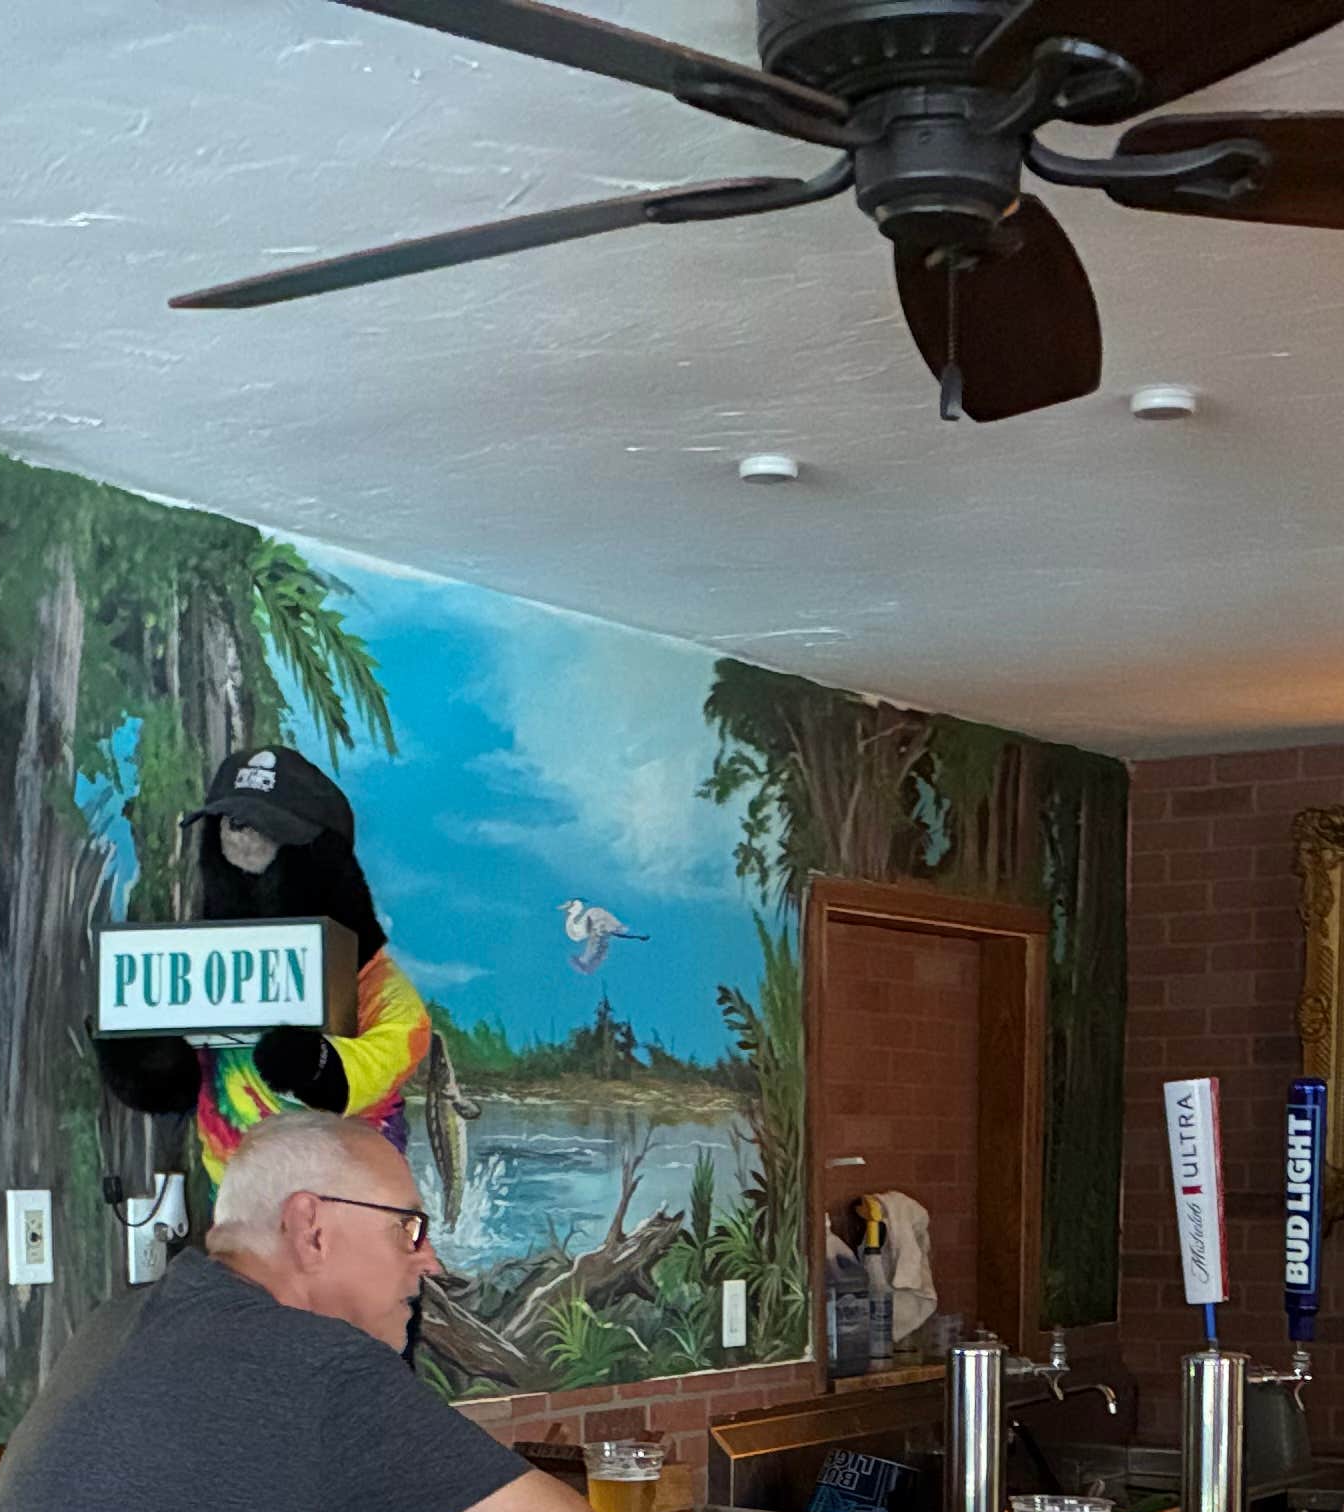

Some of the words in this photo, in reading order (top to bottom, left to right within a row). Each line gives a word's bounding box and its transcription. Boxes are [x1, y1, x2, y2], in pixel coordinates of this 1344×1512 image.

[113, 951, 193, 1008] PUB
[203, 946, 307, 1006] OPEN
[1176, 1093, 1199, 1179] ULTRA
[1286, 1113, 1313, 1212] LIGHT
[1285, 1215, 1310, 1285] BUD
